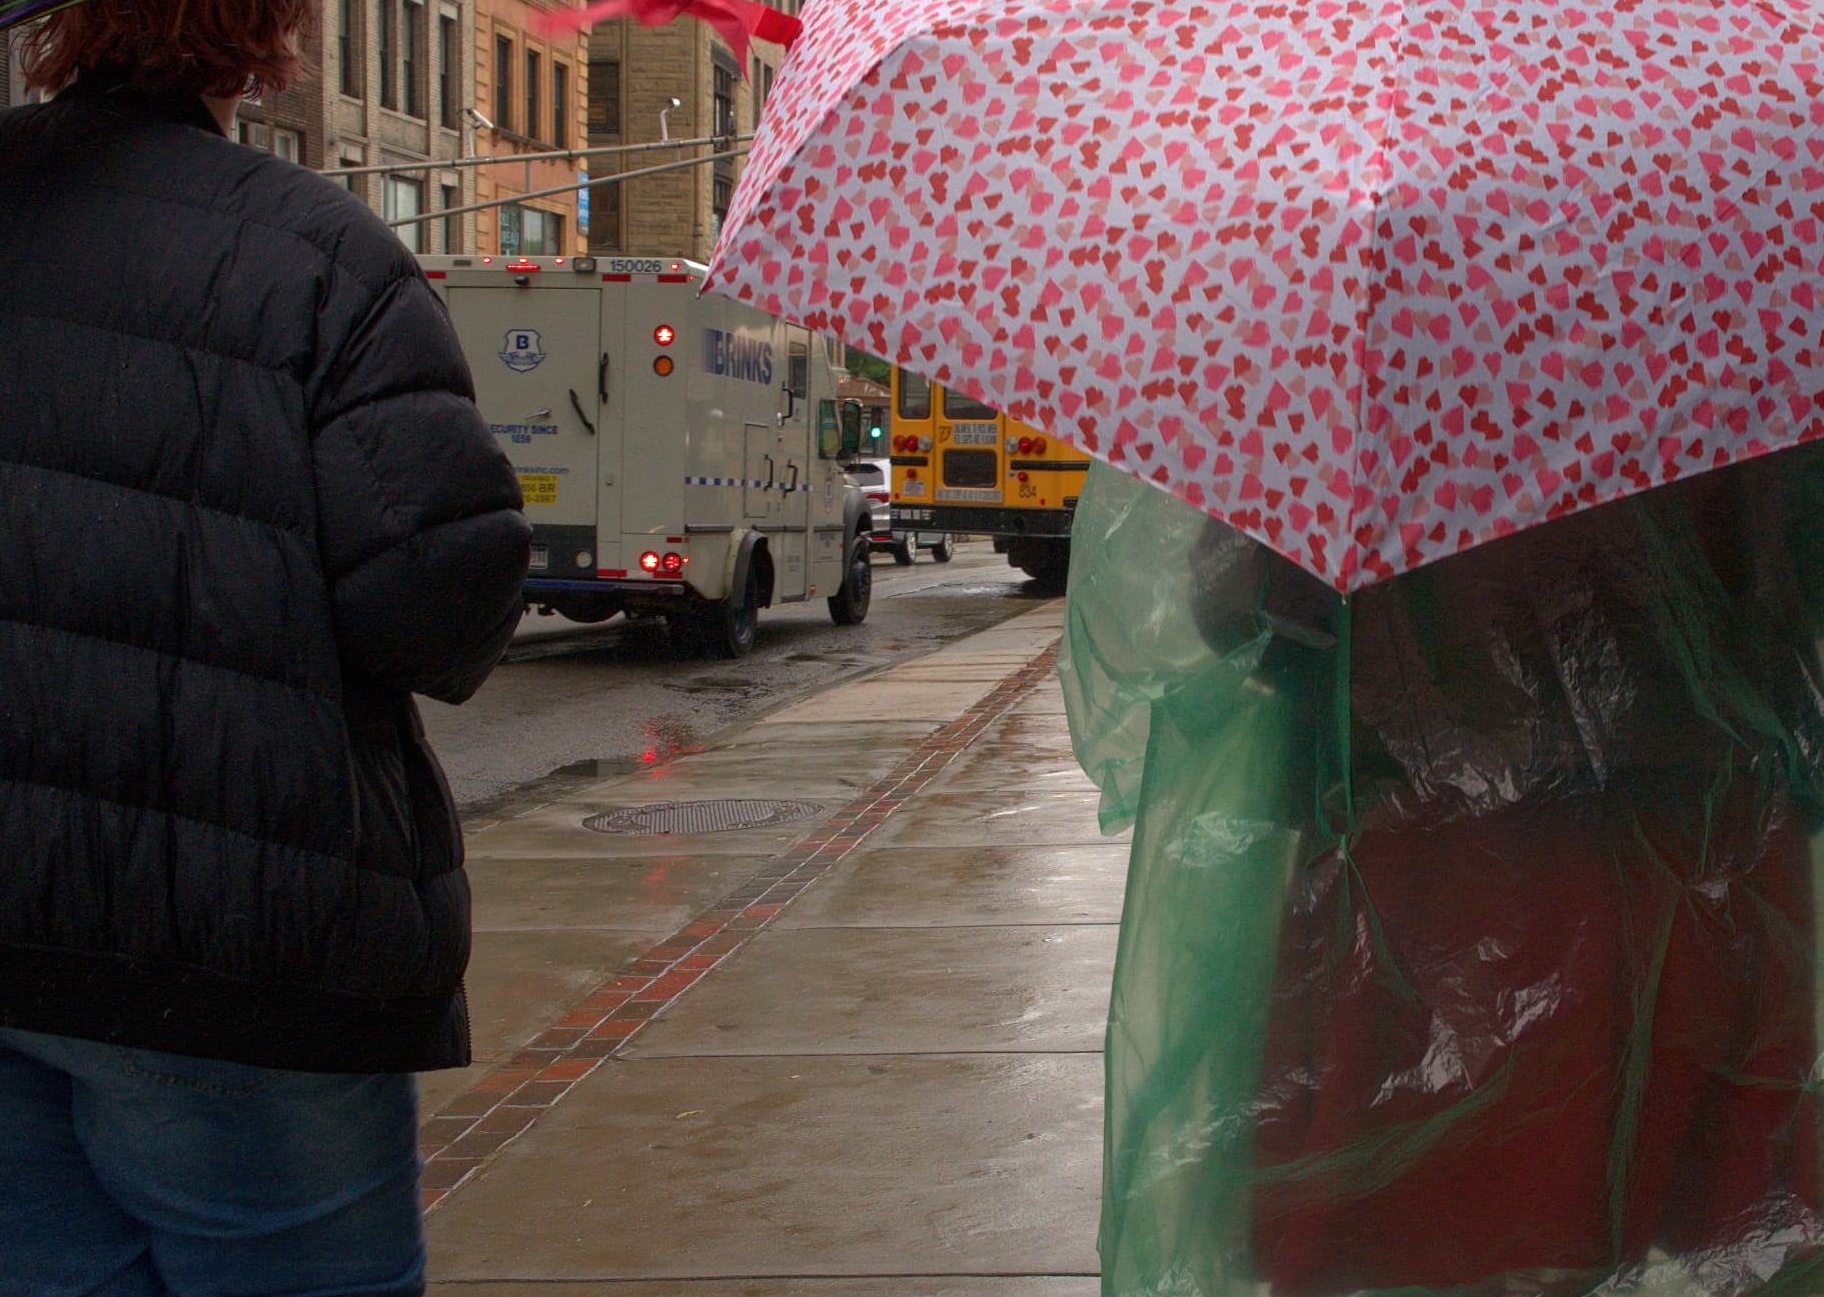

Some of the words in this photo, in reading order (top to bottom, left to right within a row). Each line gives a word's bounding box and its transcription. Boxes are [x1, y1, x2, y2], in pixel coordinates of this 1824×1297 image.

[610, 259, 662, 272] 150026
[516, 334, 530, 350] B
[710, 328, 772, 385] BRINKS
[489, 424, 529, 434] ECURITY
[531, 425, 559, 435] SINCE
[1019, 485, 1037, 498] 834
